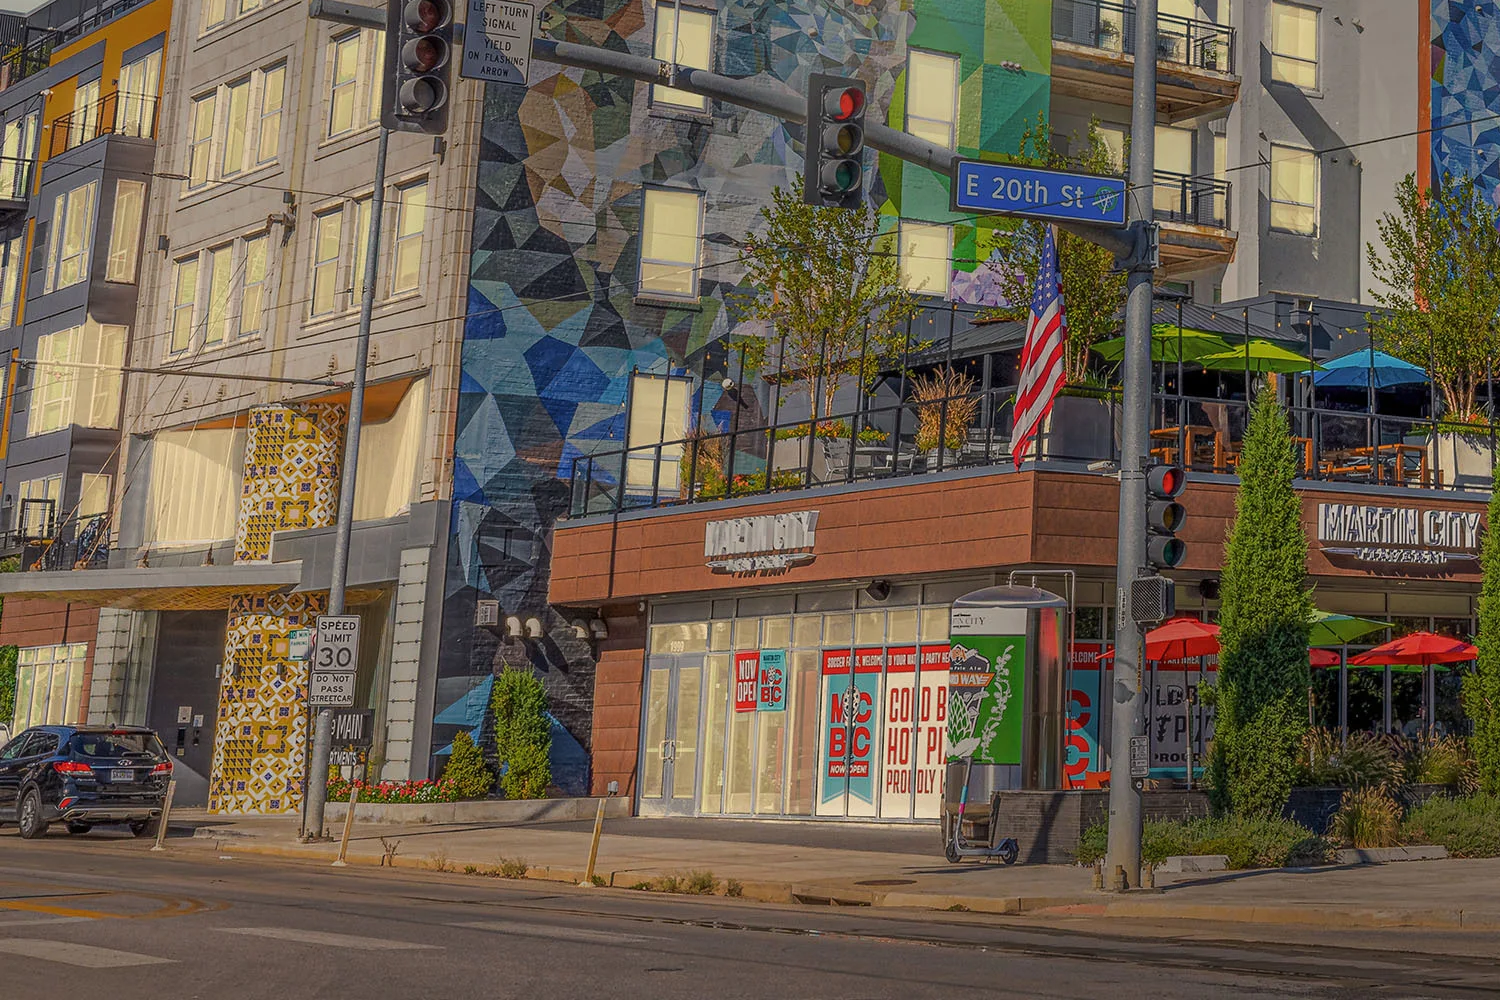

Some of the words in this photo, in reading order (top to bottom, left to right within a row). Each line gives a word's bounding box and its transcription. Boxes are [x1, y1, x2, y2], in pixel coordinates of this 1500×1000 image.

[473, 1, 496, 14] LEFT
[504, 6, 529, 18] TURN
[481, 17, 517, 31] SIGNAL
[484, 39, 511, 52] YIELD
[468, 51, 480, 60] ON
[485, 53, 524, 66] FLASHING
[480, 66, 509, 77] ARROW
[966, 174, 980, 197] E
[991, 177, 1049, 205] 20th
[1060, 185, 1085, 209] St
[1318, 503, 1419, 545] MARTIN
[1423, 510, 1481, 548] CITY
[321, 621, 356, 631] SPEED
[324, 633, 352, 643] LIMIT
[318, 647, 352, 668] 30
[827, 656, 845, 668] SOCCER
[893, 654, 907, 665] YOUR
[925, 652, 941, 664] PARTY
[332, 675, 350, 683] NOT
[311, 694, 353, 703] STREETCAR
[889, 686, 931, 722] COLD
[336, 714, 363, 739] MAIN
[829, 765, 846, 774] NOW
